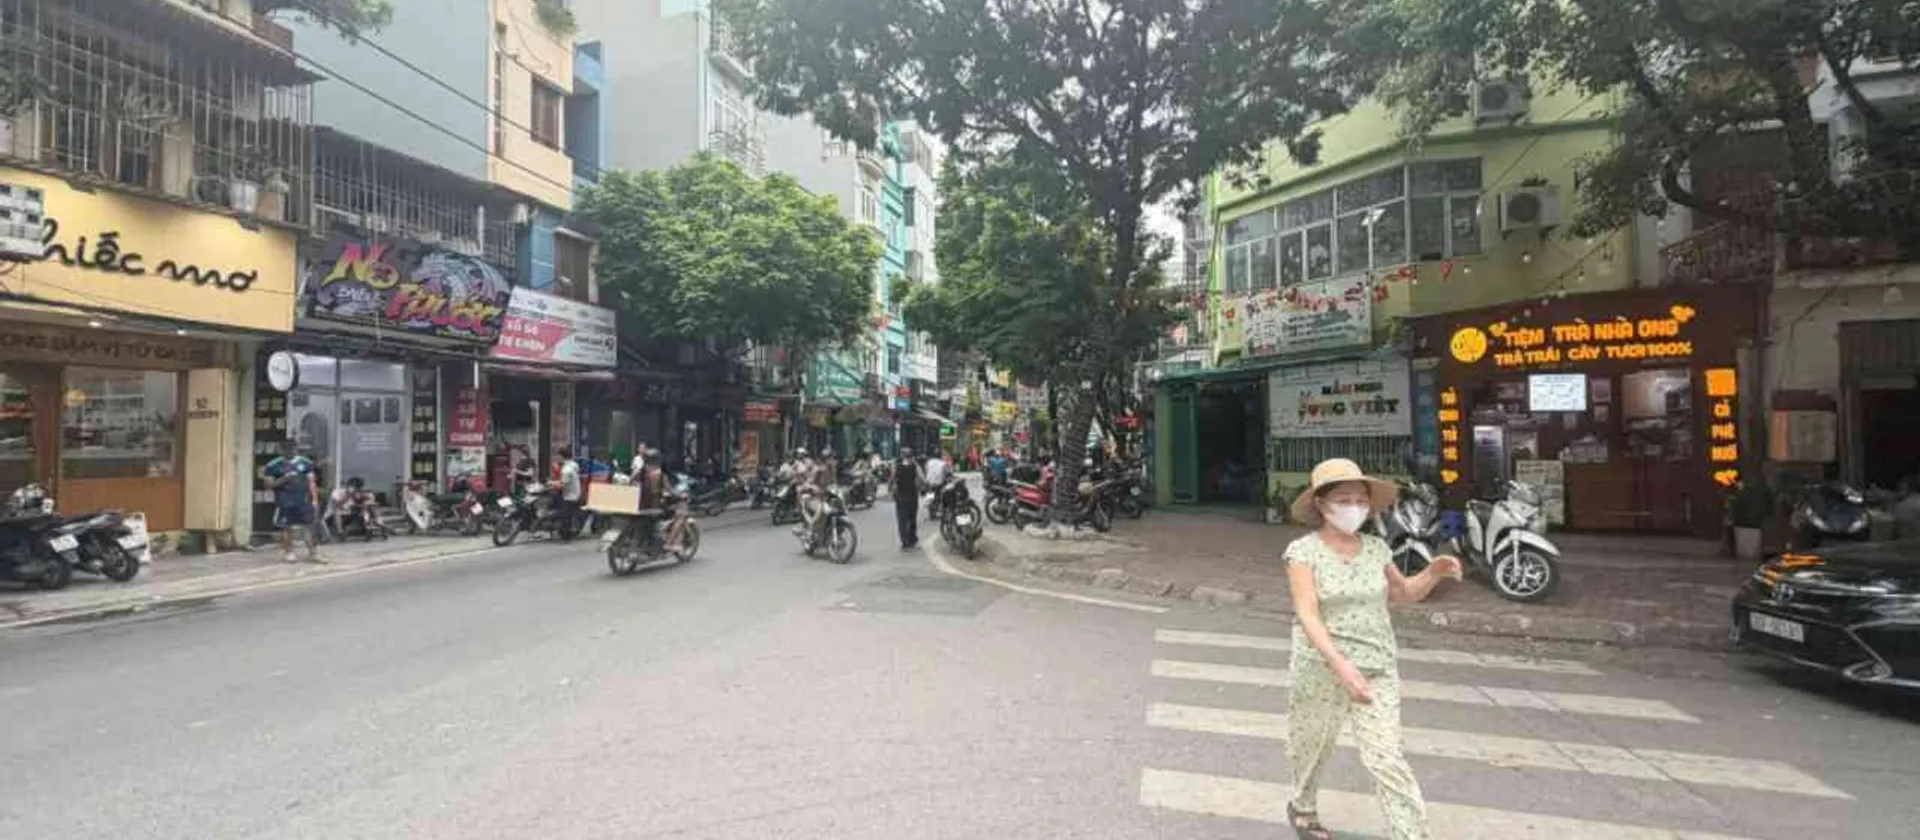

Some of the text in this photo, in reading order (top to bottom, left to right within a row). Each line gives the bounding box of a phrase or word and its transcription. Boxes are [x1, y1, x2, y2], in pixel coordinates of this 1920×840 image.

[41, 217, 258, 292] hiếc mơ
[1552, 317, 1590, 343] TRÀ
[1594, 315, 1633, 340] NHÀ
[1637, 319, 1678, 338] ONG
[1567, 343, 1600, 361] CÂY
[1646, 340, 1693, 356] 100%
